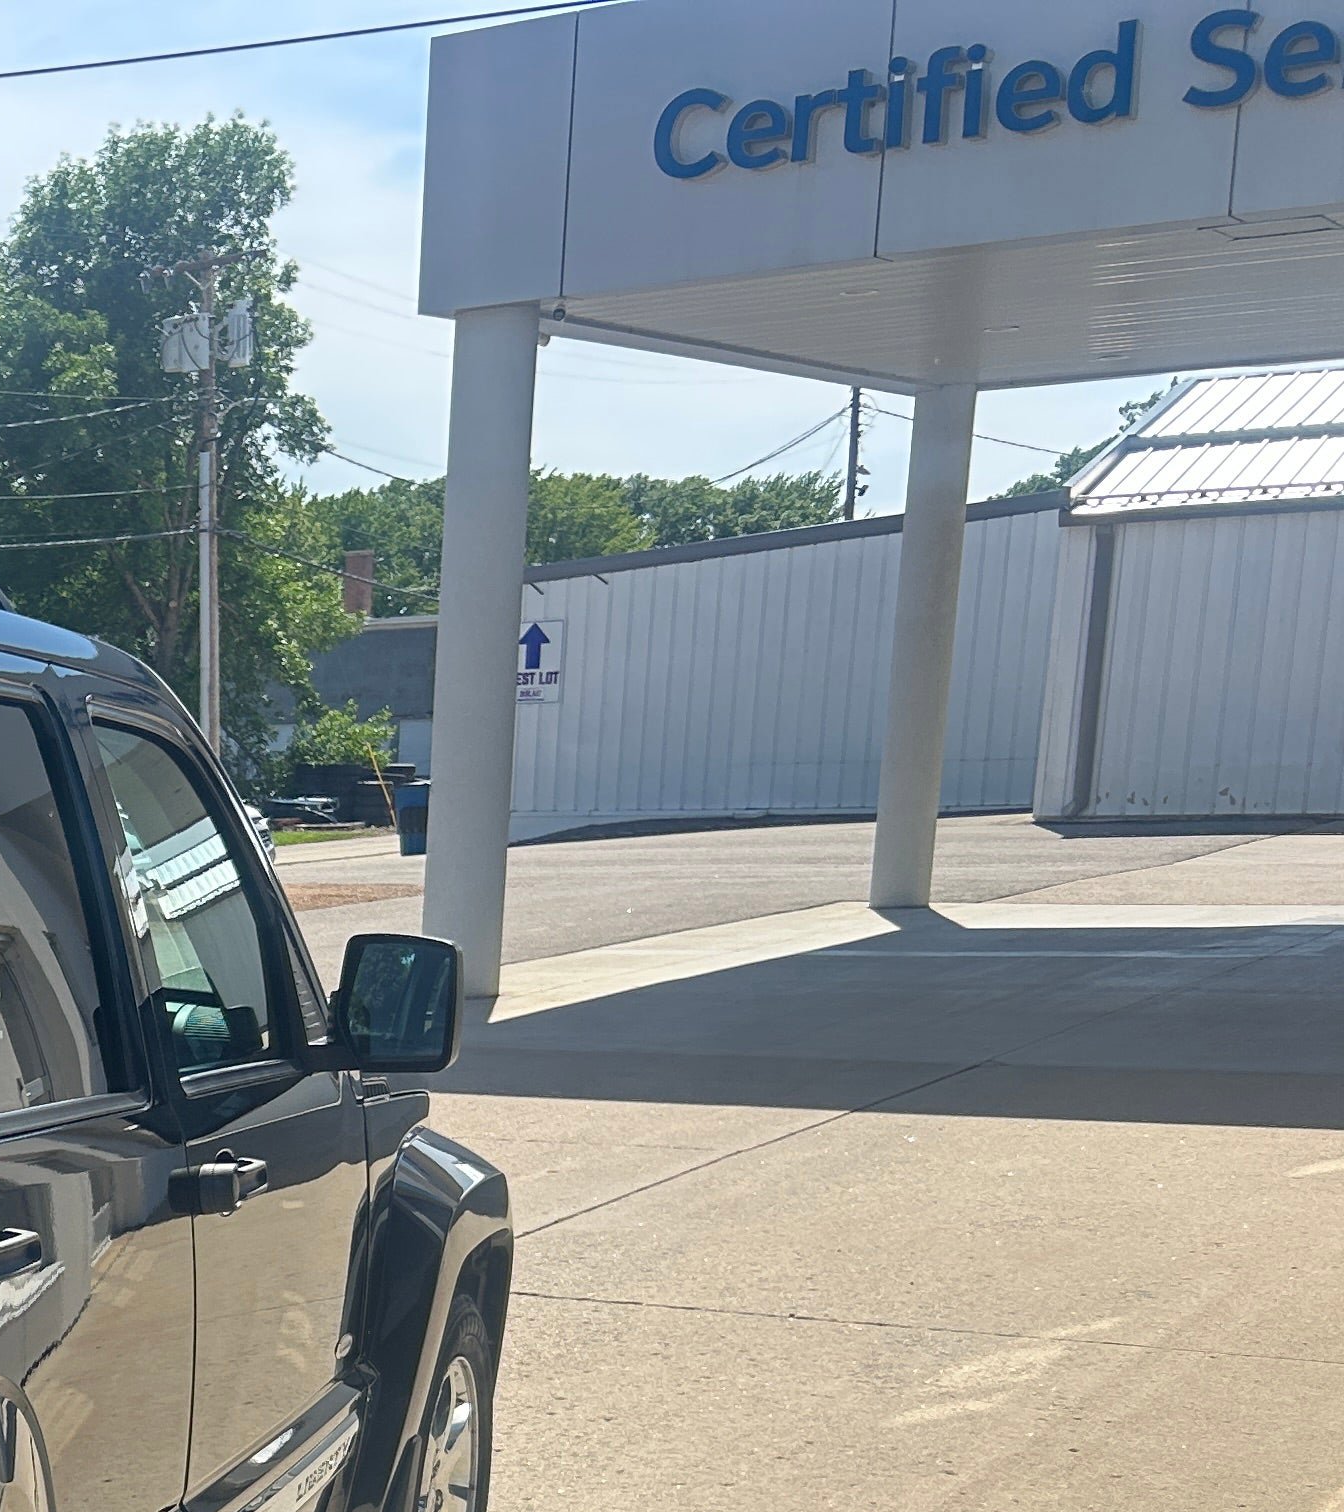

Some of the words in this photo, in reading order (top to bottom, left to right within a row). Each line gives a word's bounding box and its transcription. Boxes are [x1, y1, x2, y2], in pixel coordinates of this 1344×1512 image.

[654, 18, 1142, 180] Certified
[1182, 8, 1343, 107] Se
[516, 672, 536, 685] EST
[539, 671, 559, 685] LOT
